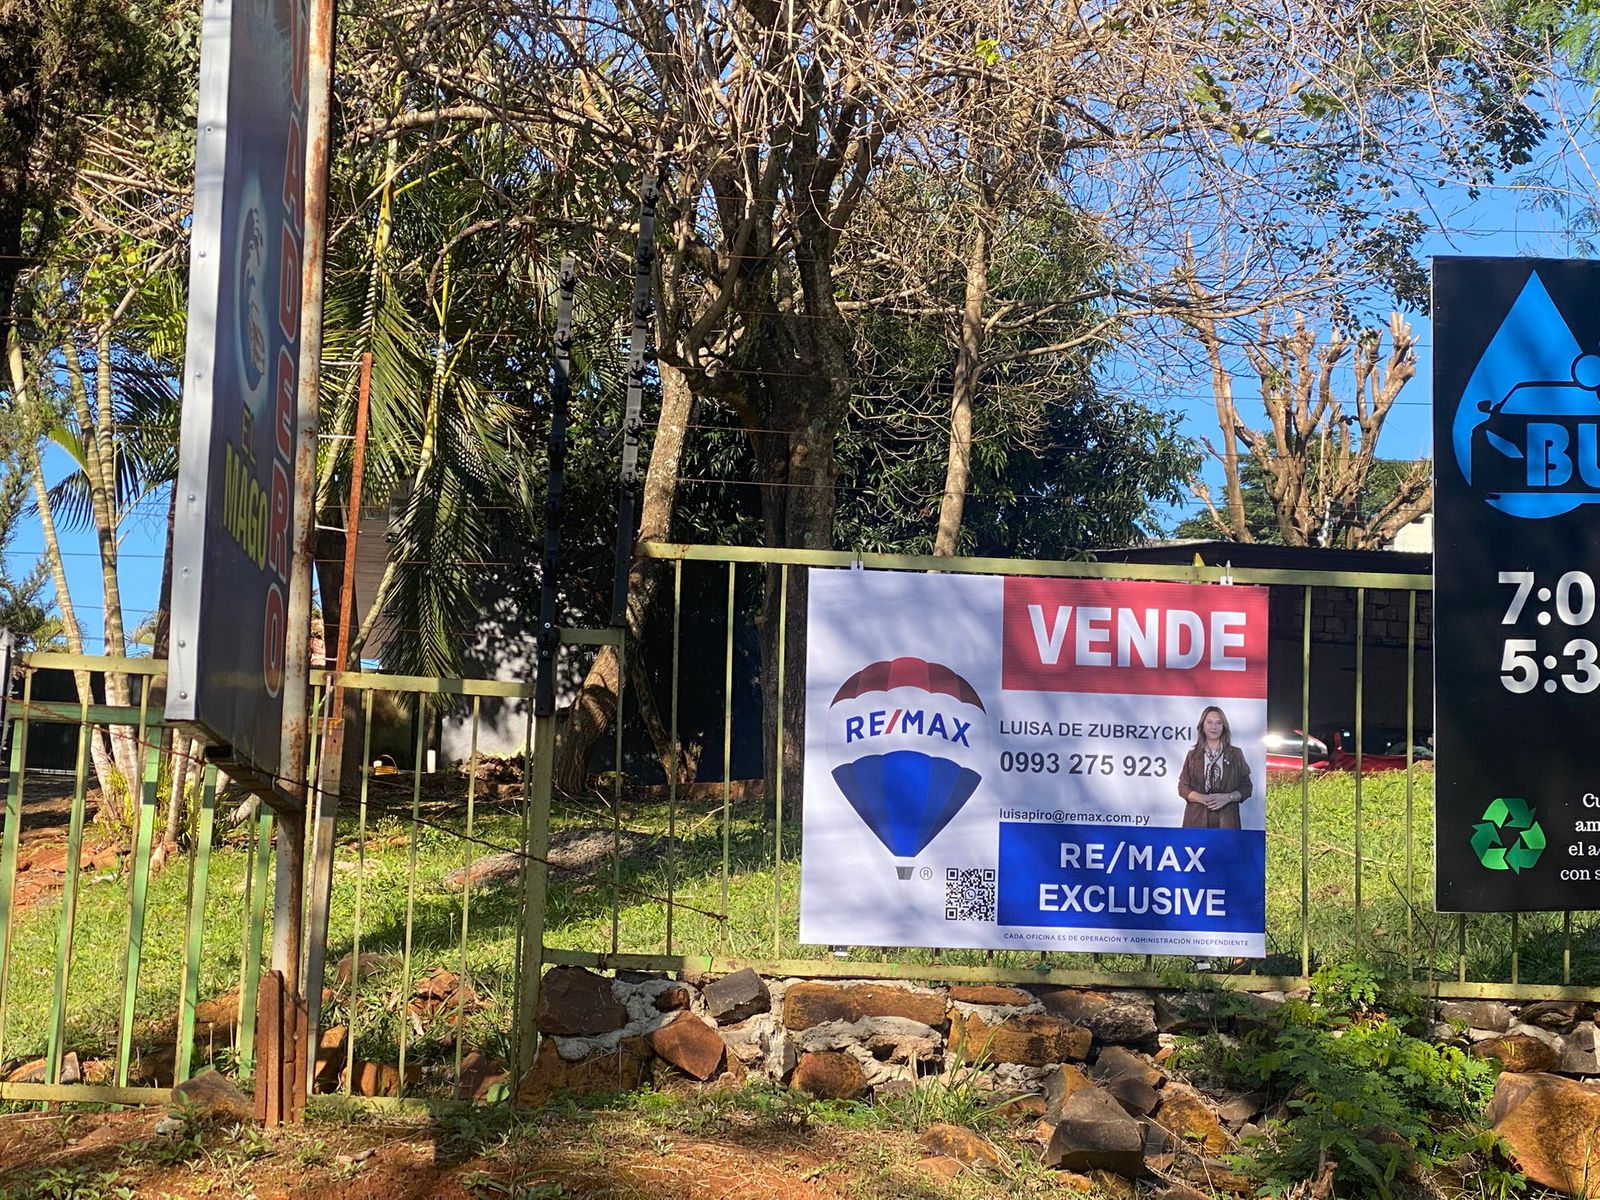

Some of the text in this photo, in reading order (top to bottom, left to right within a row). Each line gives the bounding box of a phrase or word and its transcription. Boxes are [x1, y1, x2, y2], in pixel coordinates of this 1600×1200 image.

[224, 442, 269, 571] MAGO
[1027, 603, 1247, 672] VENDE
[1500, 639, 1600, 694] 5:3
[846, 709, 971, 748] RE/MAX
[1000, 720, 1192, 741] LUISA DE ZUBRZYCKI
[1000, 751, 1168, 777] 0993 275 923
[1000, 808, 1150, 825] luisapiro@remax.com.py
[1060, 841, 1206, 875] RE/MAX
[1568, 842, 1584, 856] el
[1560, 869, 1591, 880] con
[1039, 884, 1226, 917] EXCLUSIVE
[1026, 933, 1055, 941] OFICINA
[1080, 934, 1121, 943] OPERACIÓN
[1130, 936, 1191, 945] ADMINISTRACIÓN
[1193, 939, 1249, 947] INDEPENDIENTE
